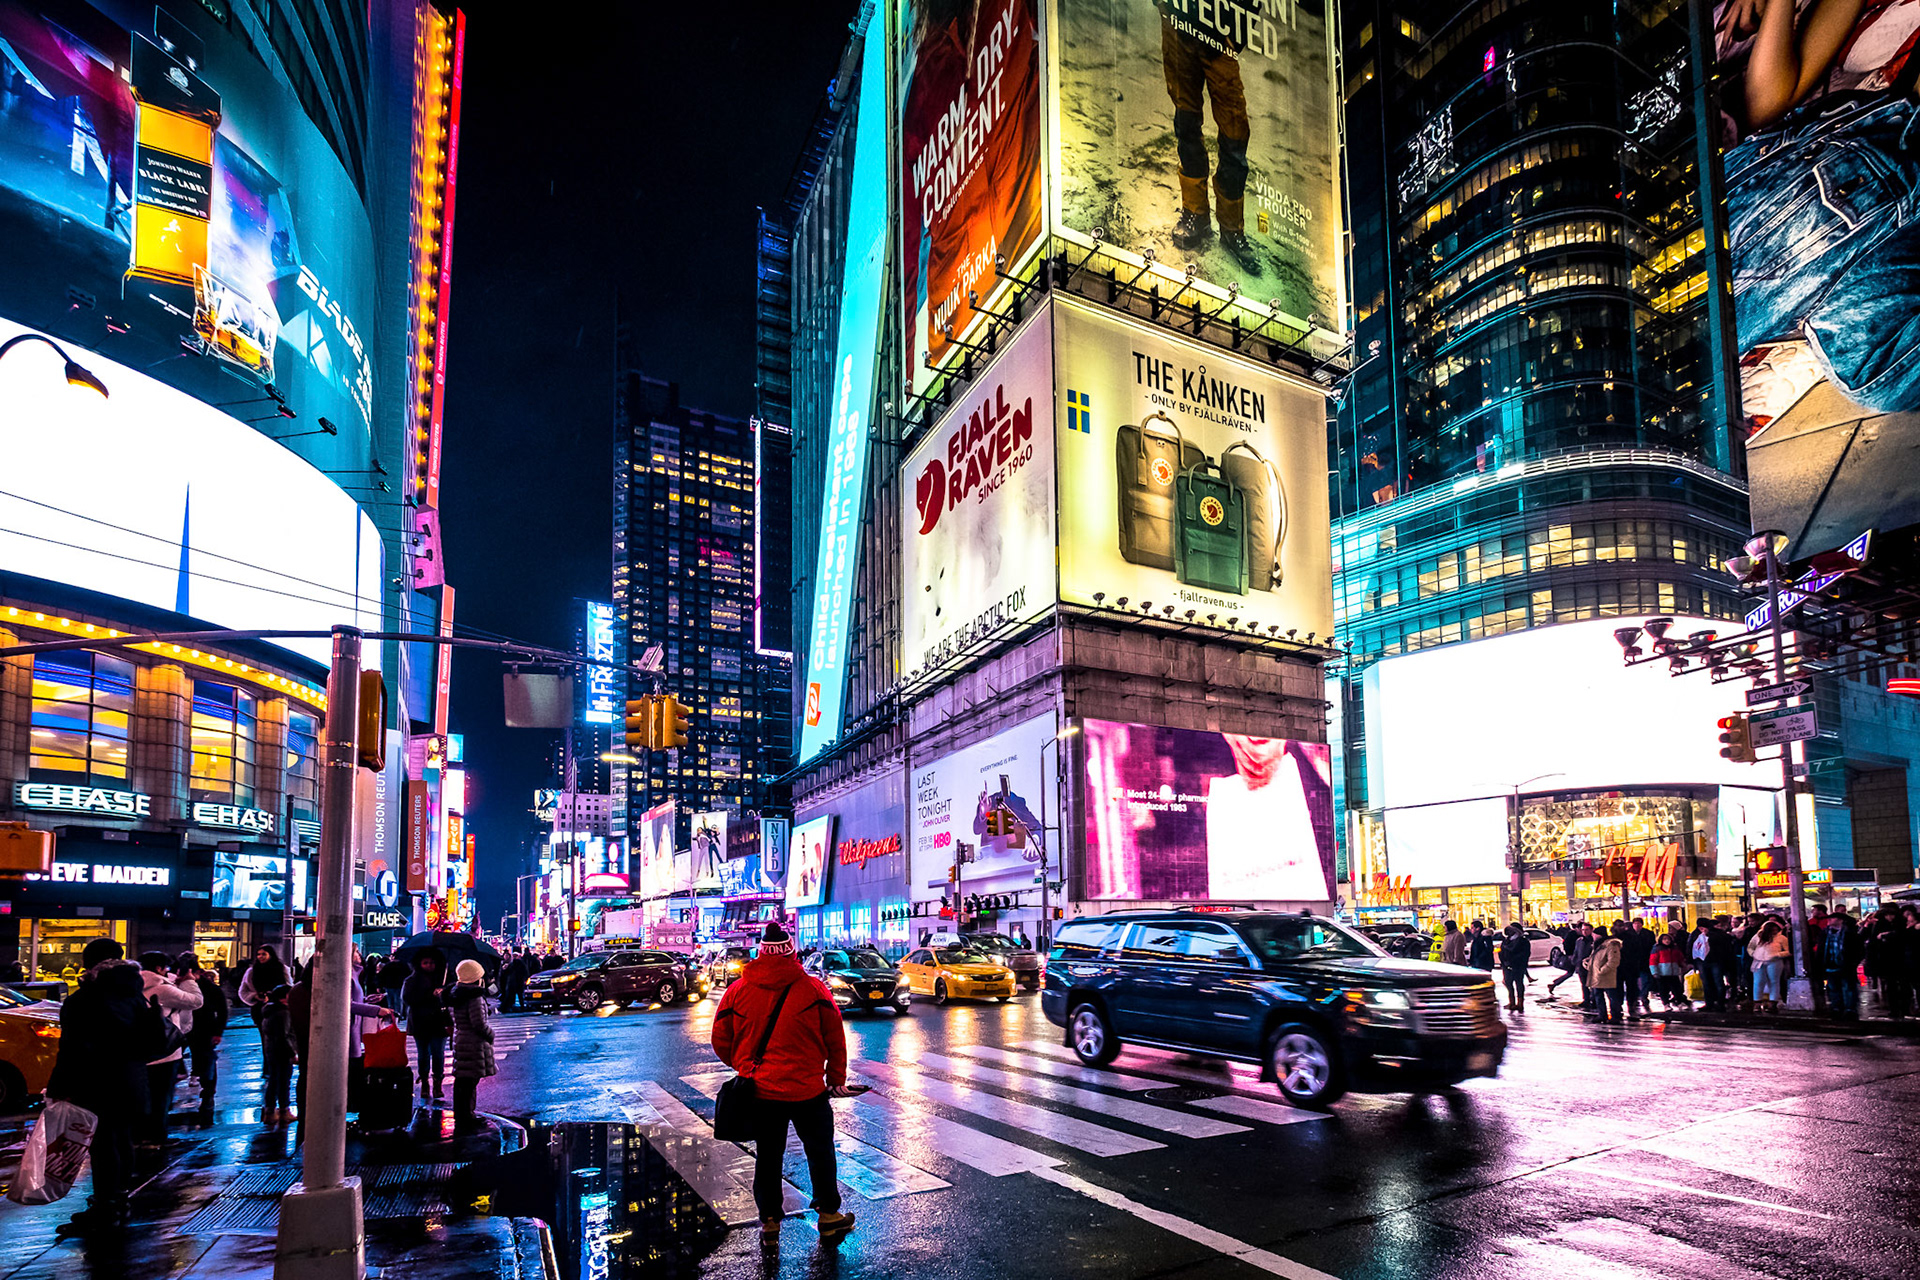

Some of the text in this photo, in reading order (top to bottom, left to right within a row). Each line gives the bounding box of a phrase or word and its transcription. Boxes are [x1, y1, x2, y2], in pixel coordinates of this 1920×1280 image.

[1170, 14, 1239, 61] fjallraven.us
[913, 0, 1018, 199] WARM. DRY.
[923, 67, 1005, 228] CONTENT.
[139, 169, 209, 195] BLACK LABEL
[1256, 181, 1312, 221] VIDDA PRO
[1256, 194, 1306, 230] TROUSER
[957, 253, 971, 278] THE
[934, 234, 996, 335] NUUK PARKA
[296, 264, 363, 363] BLADE
[1313, 348, 1348, 369] SHEROOD
[1132, 351, 1265, 423] THE KÅNKEN
[1152, 393, 1252, 433] ONLY BY FJÄLLRÄVEN
[978, 444, 1033, 504] SINCE 1960
[814, 353, 853, 671] Child-resistant caps
[824, 535, 848, 669] launched
[838, 498, 852, 525] in
[1007, 585, 1026, 617] FOX
[1180, 590, 1238, 610] fjallraven.us
[1754, 683, 1803, 700] ONE WAY
[1787, 725, 1807, 733] PASS
[918, 771, 935, 789] LAST
[980, 761, 1004, 773] EVERYTHING
[1813, 761, 1822, 772] 7
[20, 783, 151, 816] CHASE
[375, 768, 387, 854] THOMSON REUT
[918, 786, 939, 804] WEEK
[918, 798, 952, 819] TONIGHT
[1127, 789, 1147, 799] Most
[1178, 793, 1209, 803] pharmac
[194, 802, 274, 832] CHASE
[771, 823, 779, 870] NYPD
[839, 832, 900, 869] Walgreens
[934, 831, 951, 849] HBO
[25, 863, 169, 887] EVE MADDEN
[367, 912, 400, 927] CHASE
